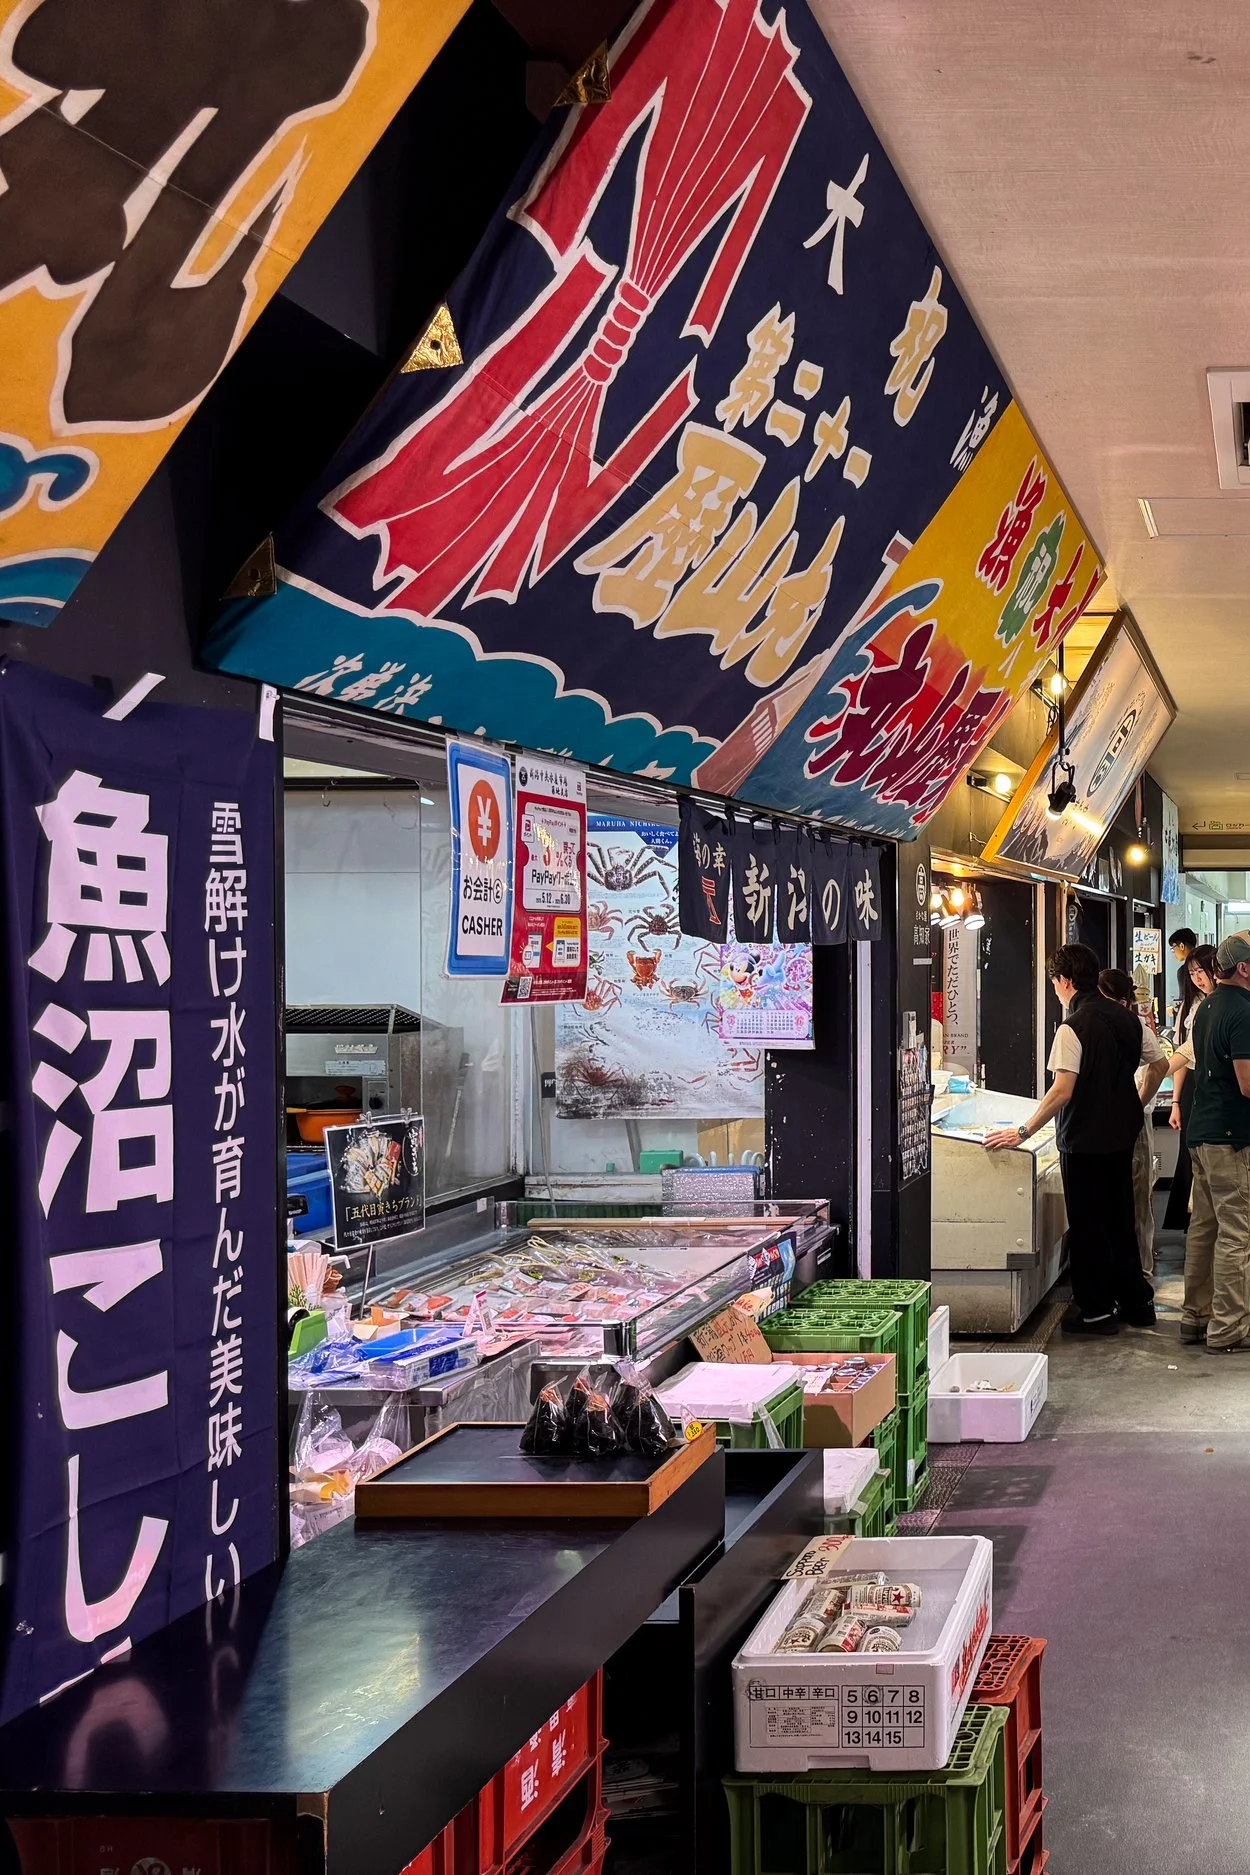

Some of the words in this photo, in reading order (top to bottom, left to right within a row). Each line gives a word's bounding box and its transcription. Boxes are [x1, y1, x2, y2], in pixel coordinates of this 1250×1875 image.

[462, 874, 504, 904] お会計②
[462, 915, 504, 937] CASHER
[946, 928, 960, 1025] 世界でただひとつ、
[203, 801, 249, 1600] 雪解け水が育んだ美味しい
[28, 769, 174, 1700] 魚沼こし
[752, 1687, 776, 1698] 甘口
[782, 1687, 806, 1698] 中辛
[812, 1687, 835, 1698] 辛口
[847, 1690, 858, 1703] 5
[867, 1690, 879, 1703] 6
[887, 1690, 899, 1703] 7
[908, 1690, 920, 1703] 8
[847, 1710, 858, 1724] 9
[865, 1711, 882, 1724] 10
[885, 1711, 899, 1724] 11
[906, 1711, 923, 1724] 12
[844, 1731, 861, 1744] 13
[865, 1731, 881, 1744] 14
[885, 1731, 902, 1744] 15
